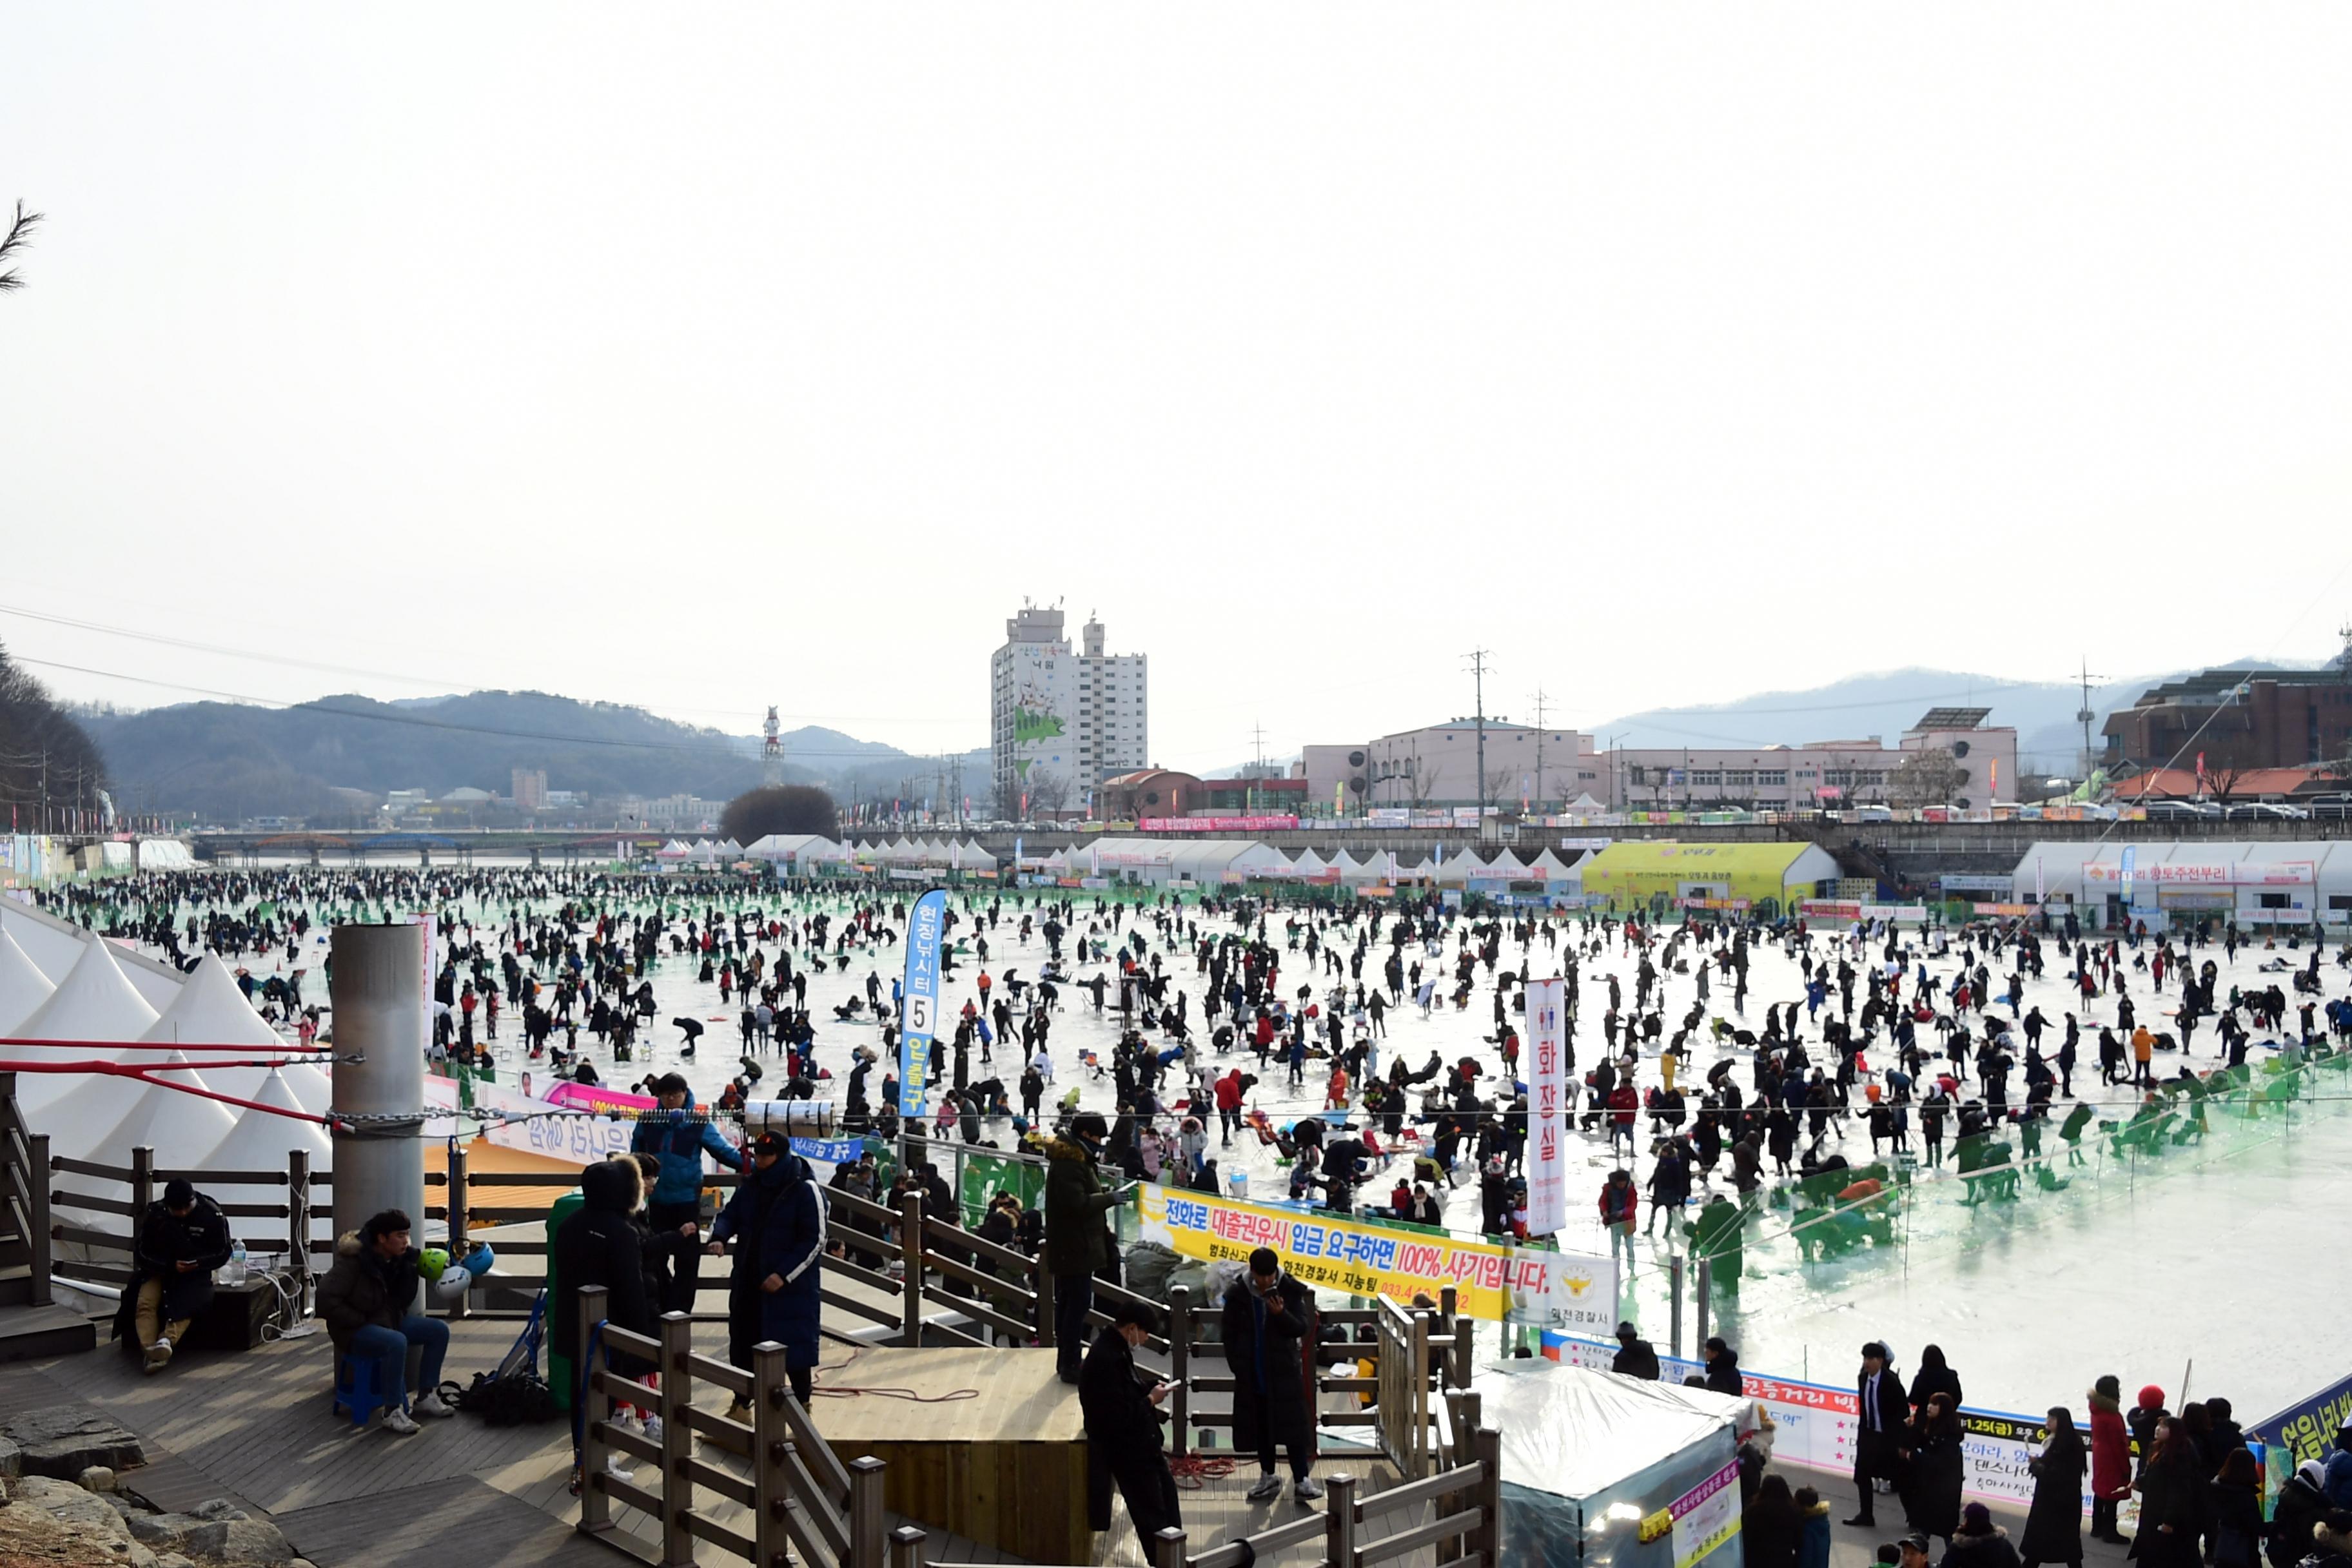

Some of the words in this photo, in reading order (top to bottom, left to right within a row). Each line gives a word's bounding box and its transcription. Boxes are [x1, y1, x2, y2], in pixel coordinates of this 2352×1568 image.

[914, 904, 937, 994] 현장낚시터
[914, 999, 926, 1028] 5
[1538, 1040, 1557, 1162] 화장실
[1166, 1199, 1209, 1231] 전화로
[1211, 1208, 1289, 1250] 대출권유시
[1291, 1223, 1324, 1256] 입금
[1326, 1231, 1396, 1270] 요구하면
[1397, 1244, 1441, 1278] 100%
[1444, 1250, 1551, 1295] 사기입니다.
[1283, 1259, 1339, 1285] 화천경찰서
[1342, 1271, 1378, 1293] 지능팀
